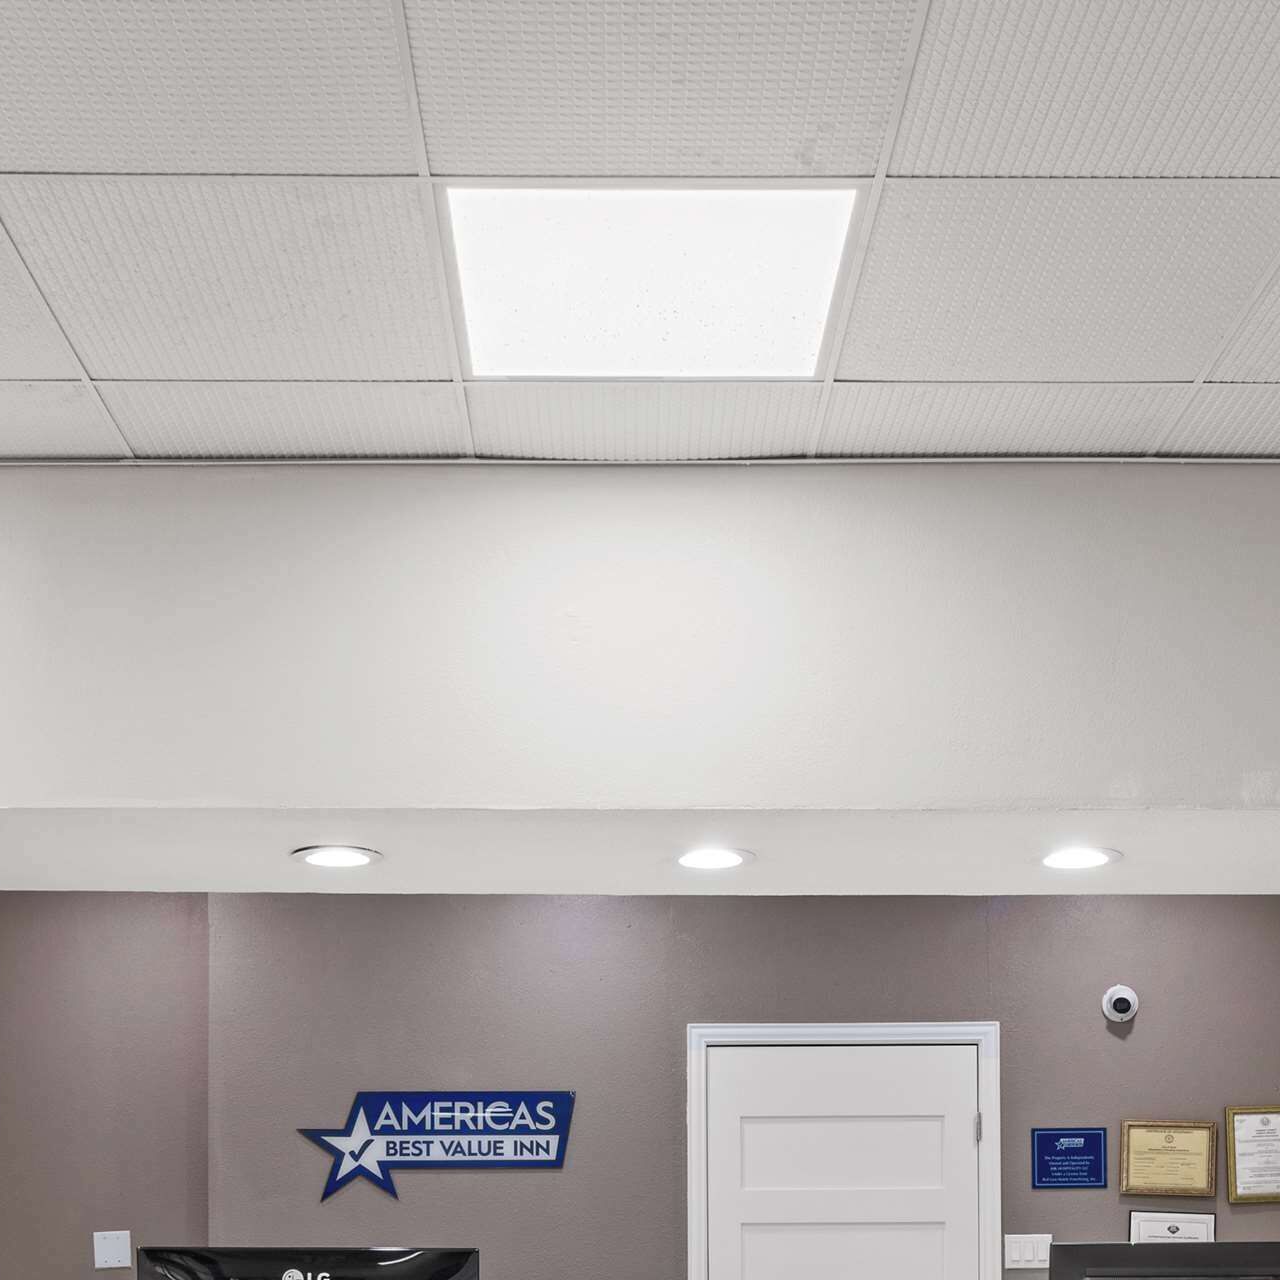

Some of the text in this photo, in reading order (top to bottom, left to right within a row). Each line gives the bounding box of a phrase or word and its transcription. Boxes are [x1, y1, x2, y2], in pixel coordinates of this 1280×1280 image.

[373, 1101, 556, 1131] AMERICAS
[386, 1140, 551, 1157] BEST VALUE INN
